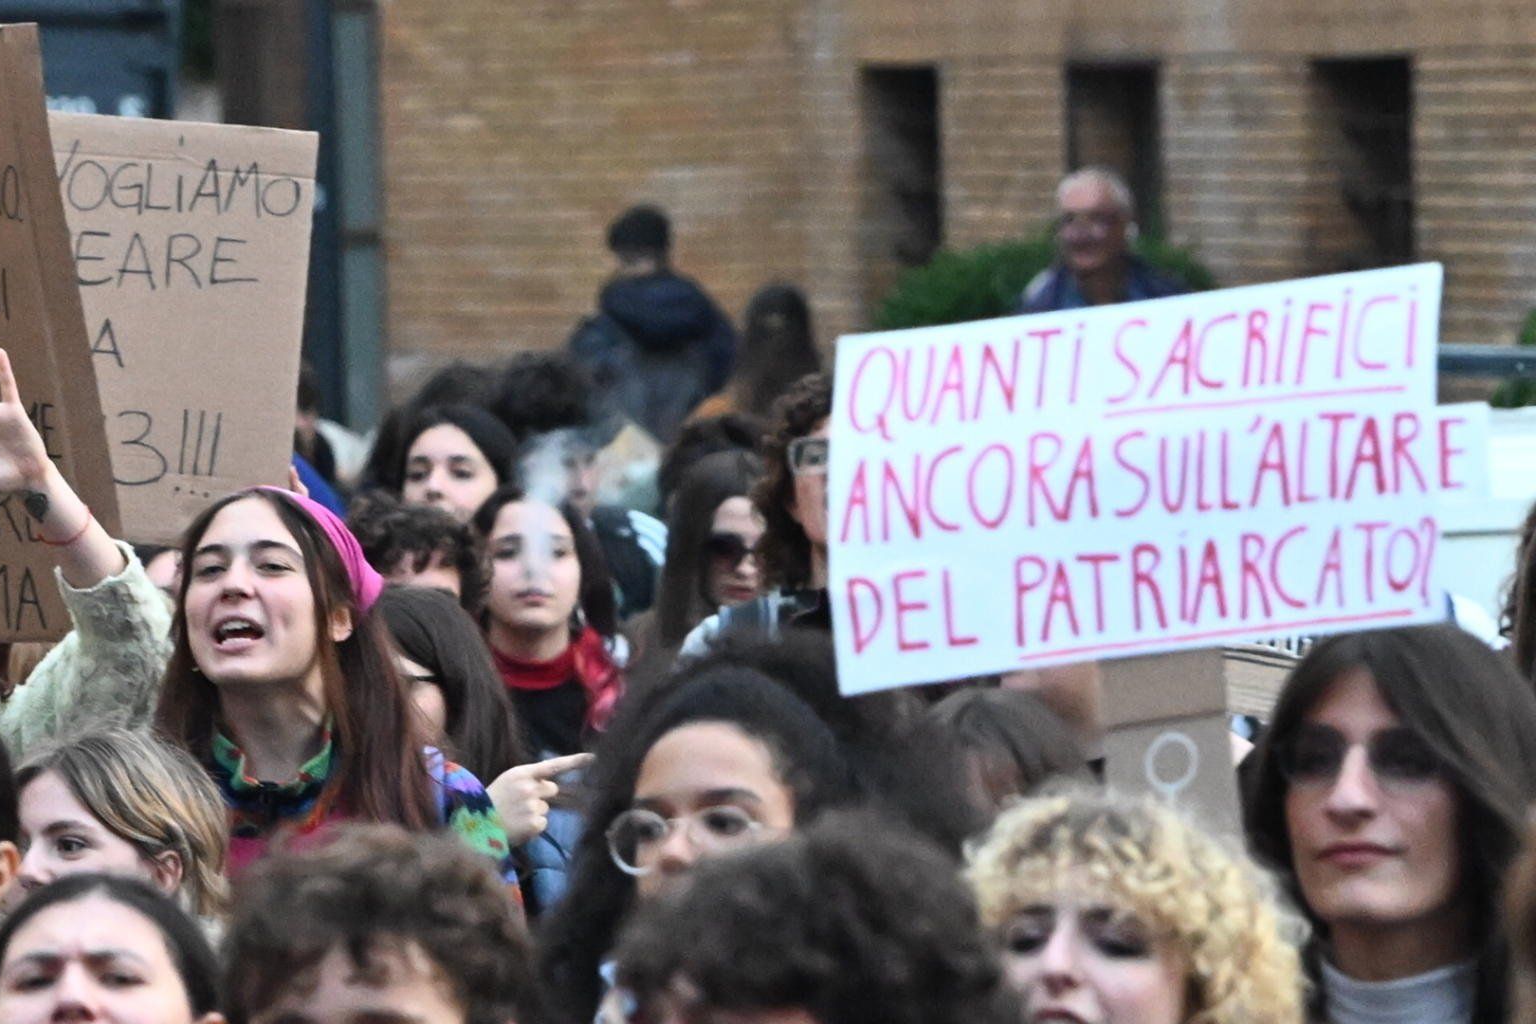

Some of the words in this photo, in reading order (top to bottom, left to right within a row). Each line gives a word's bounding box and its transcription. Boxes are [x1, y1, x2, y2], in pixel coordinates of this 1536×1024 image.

[75, 231, 260, 290] EARE
[840, 432, 1100, 544] ANCORA
[1113, 411, 1467, 520] SULL'ALTARE
[846, 564, 979, 656] DEL
